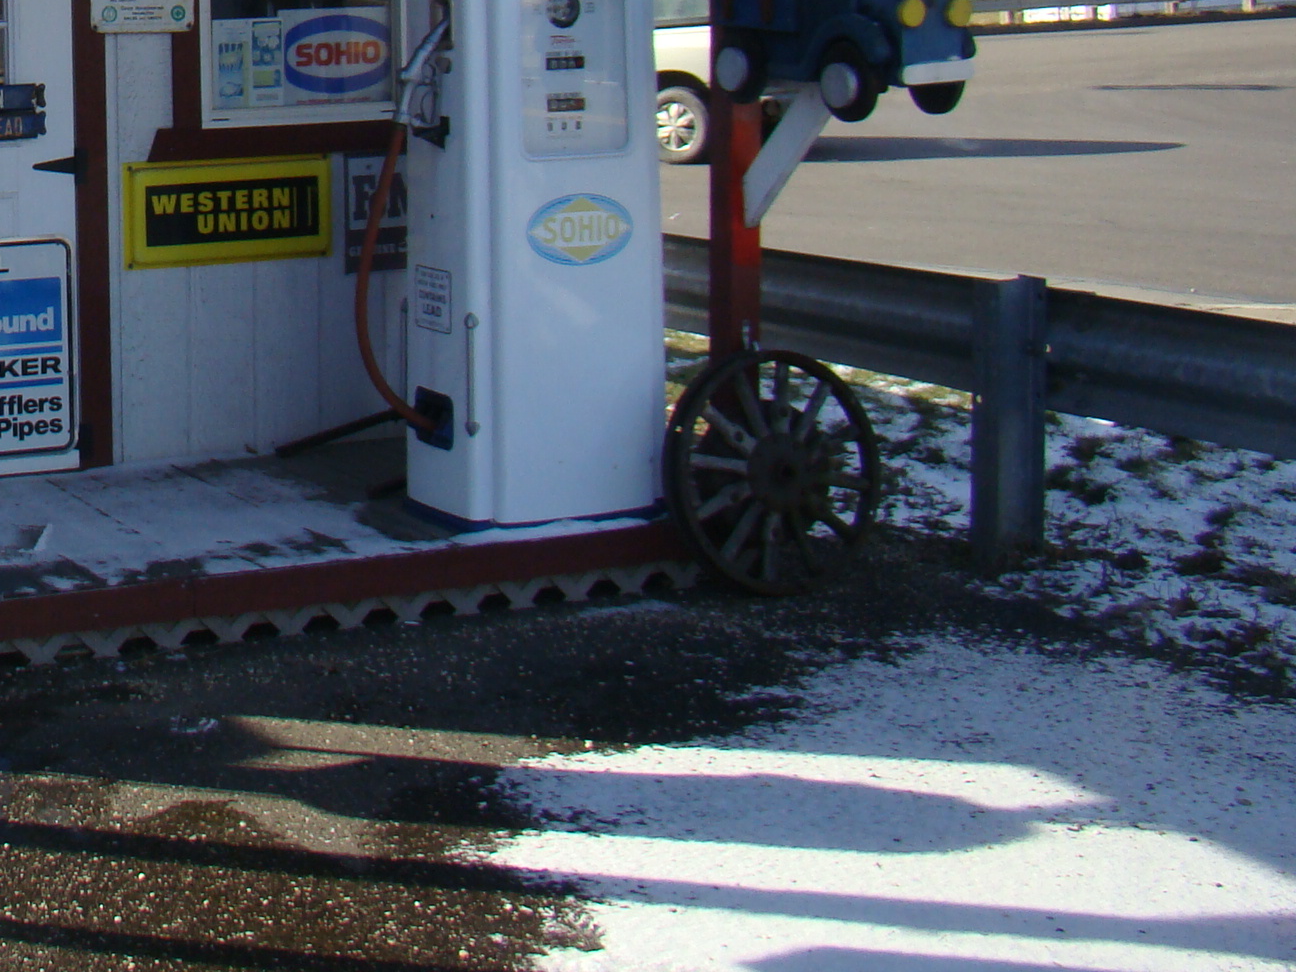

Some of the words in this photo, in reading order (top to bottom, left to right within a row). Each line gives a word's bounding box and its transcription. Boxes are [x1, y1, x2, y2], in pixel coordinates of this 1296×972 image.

[295, 40, 382, 67] SOHIO
[152, 187, 291, 215] WESTERN
[197, 208, 291, 234] UNION
[542, 214, 621, 246] SOHIO
